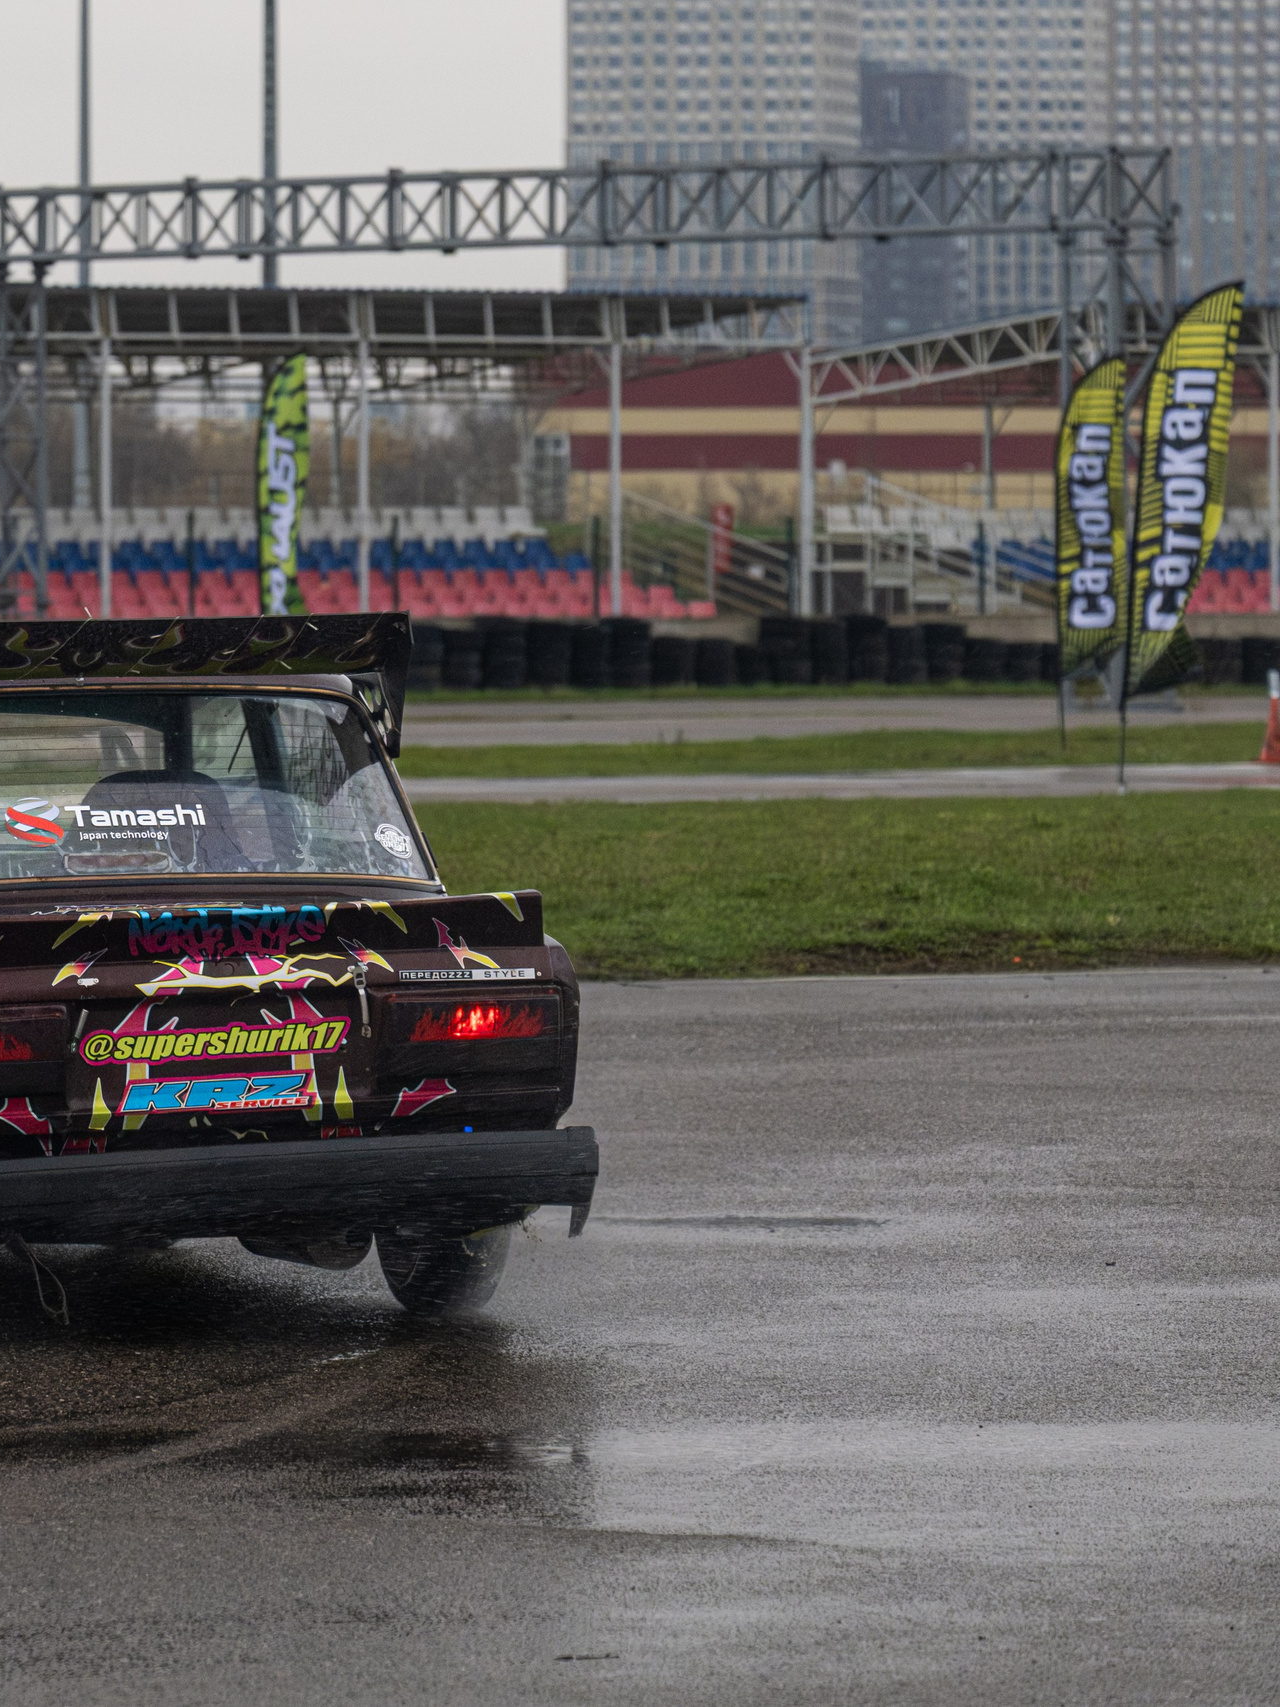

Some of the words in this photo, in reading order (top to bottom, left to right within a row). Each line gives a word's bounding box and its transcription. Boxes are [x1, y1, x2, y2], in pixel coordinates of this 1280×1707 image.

[64, 803, 206, 827] Tamashi
[79, 831, 108, 841] Japan
[110, 830, 169, 841] technology
[484, 970, 526, 978] STYLE
[85, 1021, 346, 1061] @supershurik17
[121, 1073, 306, 1112] KRZ
[215, 1096, 309, 1110] SERVICE
